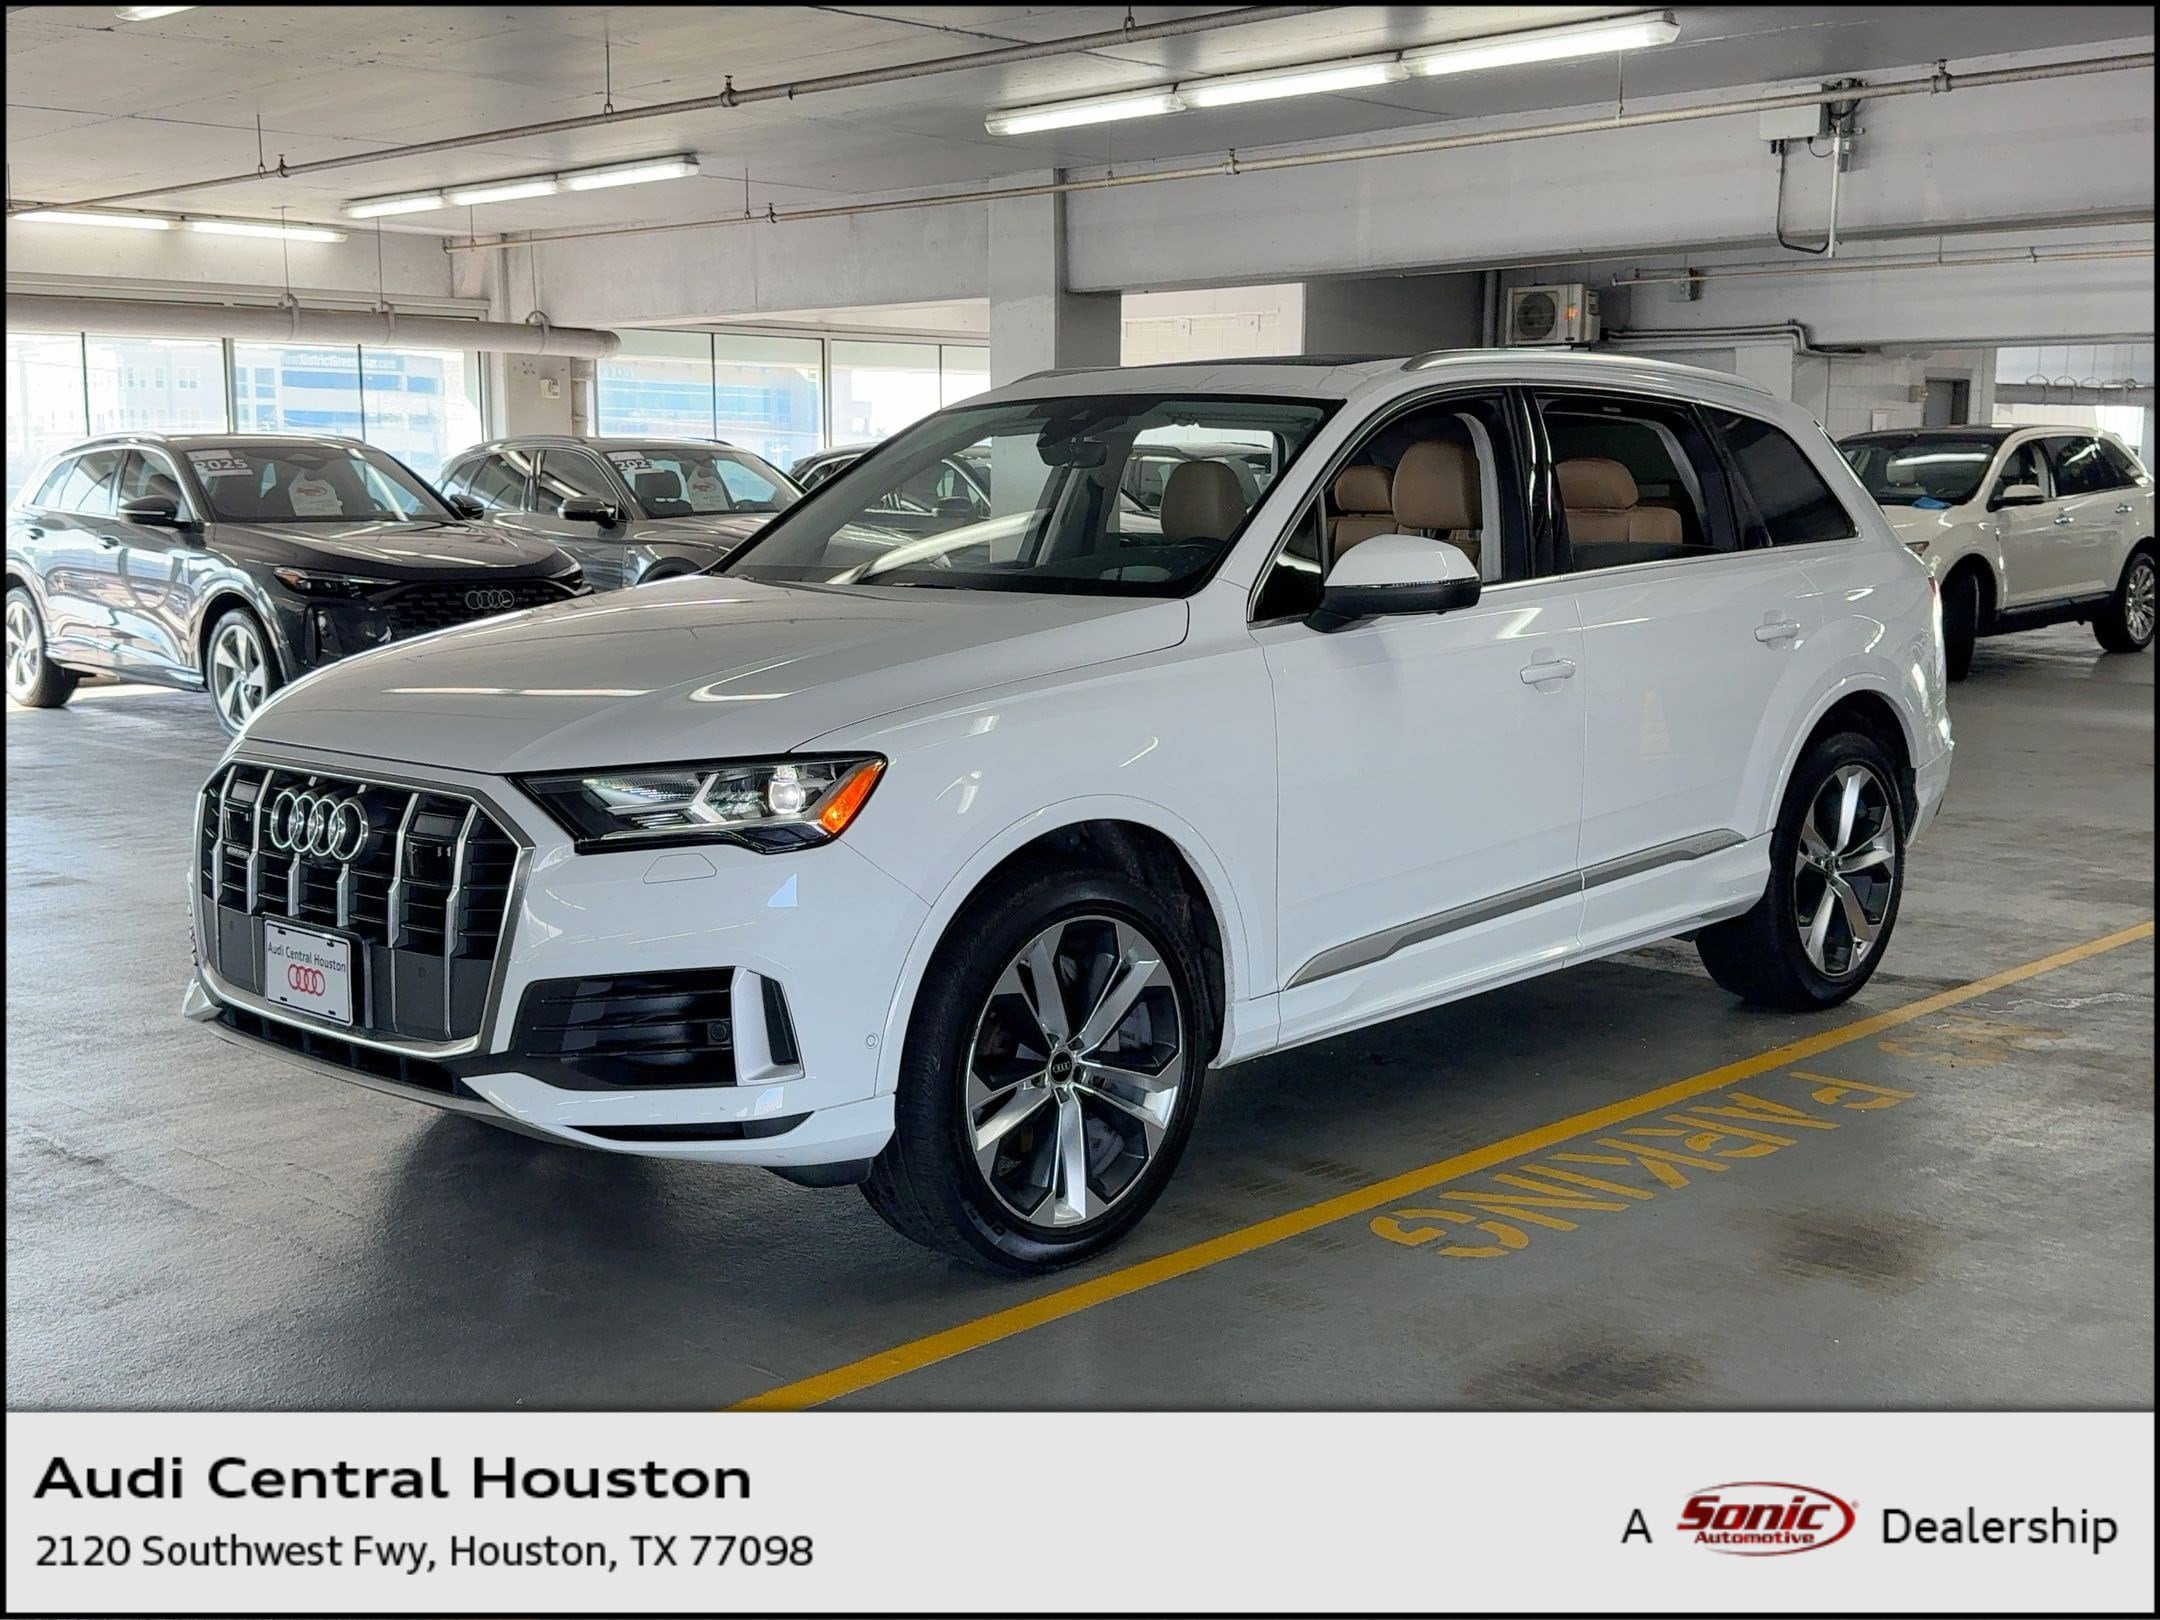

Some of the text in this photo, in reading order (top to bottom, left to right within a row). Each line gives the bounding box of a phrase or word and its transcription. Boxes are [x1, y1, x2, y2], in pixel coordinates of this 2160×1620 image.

[193, 458, 249, 472] 2025
[268, 941, 346, 972] Audi Central Houston
[1369, 1071, 1916, 1258] PARKING
